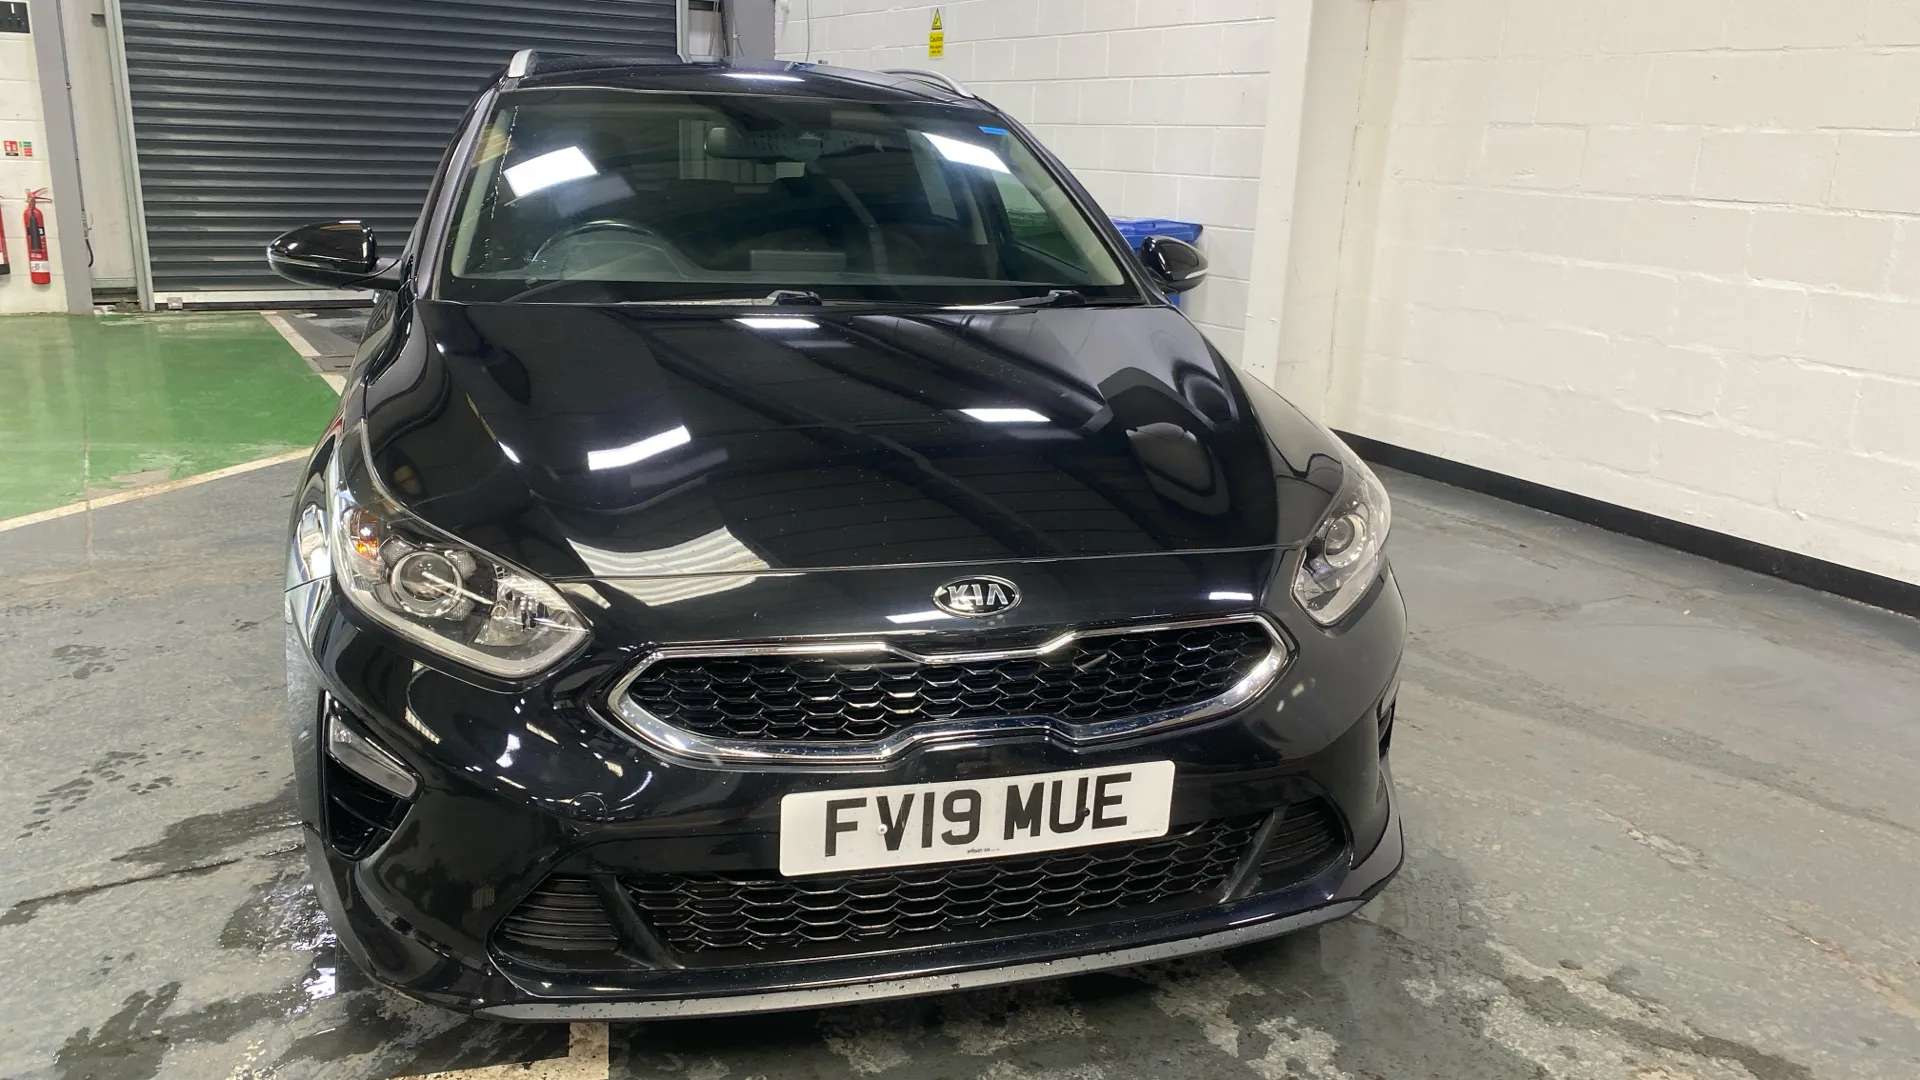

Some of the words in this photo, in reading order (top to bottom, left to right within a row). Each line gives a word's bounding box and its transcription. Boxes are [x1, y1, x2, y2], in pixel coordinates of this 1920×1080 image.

[947, 584, 1009, 606] KIA
[825, 789, 982, 857] FV19
[1004, 772, 1132, 840] MUE
